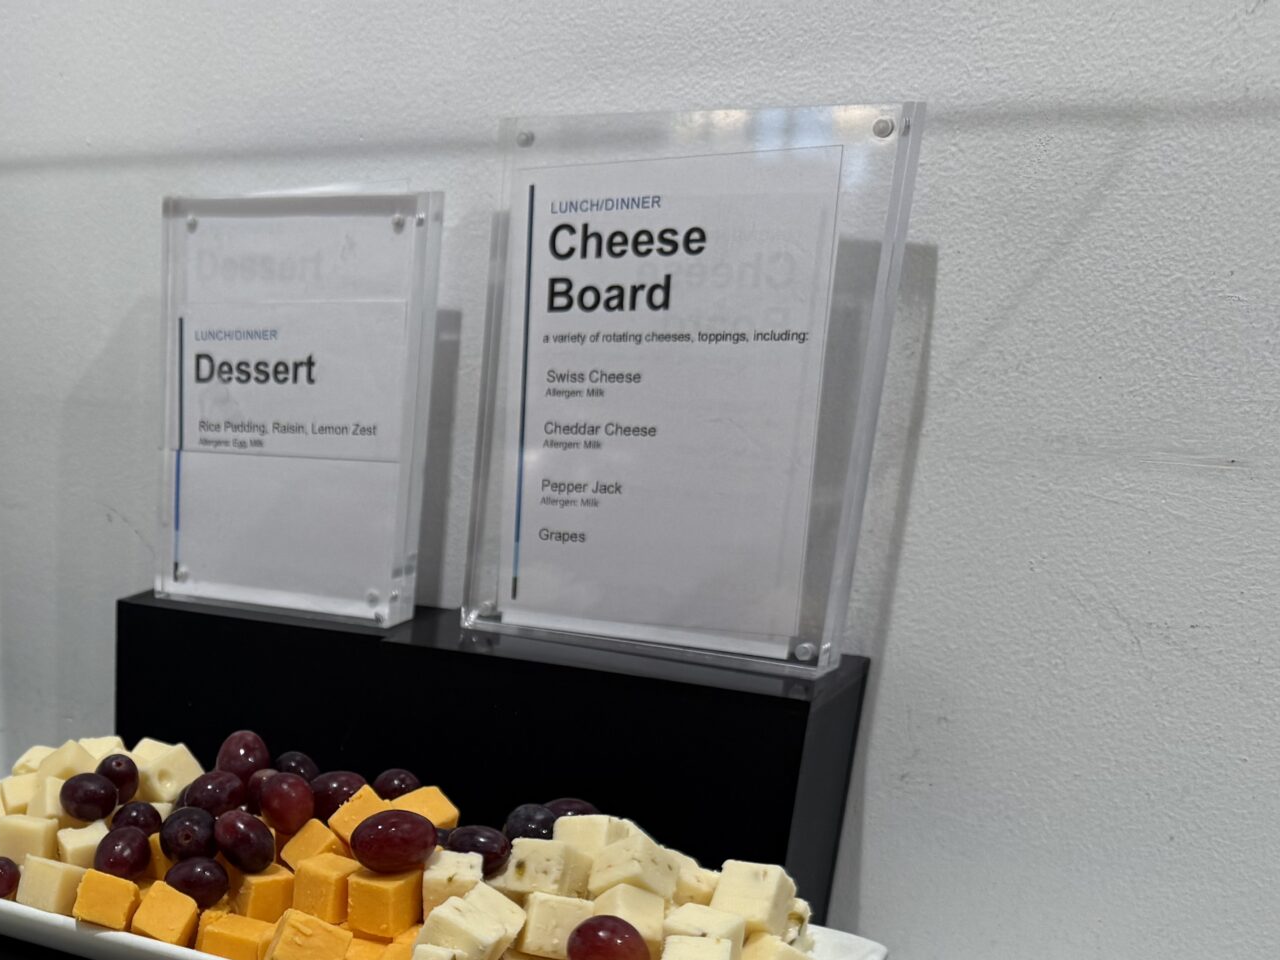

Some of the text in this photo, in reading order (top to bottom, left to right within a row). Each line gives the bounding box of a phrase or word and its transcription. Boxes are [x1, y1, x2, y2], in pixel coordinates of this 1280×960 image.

[550, 195, 662, 214] LUNCH/DINNER
[548, 223, 707, 261] Cheese
[547, 274, 672, 313] Board
[194, 329, 278, 341] LUNCH/DINNER
[543, 330, 809, 346] a variety of rotating cheeses, toppings, including:
[194, 353, 316, 385] Dessert
[546, 370, 642, 384] Swiss Cheese
[586, 388, 605, 397] Milk
[199, 420, 221, 433] Rice
[272, 422, 308, 436] Raisin,
[311, 423, 348, 436] Lemon
[352, 424, 377, 437] Zest
[543, 421, 657, 437] Cheddar Cheese
[583, 440, 602, 449] Milk
[541, 479, 622, 495] Pepper Jack
[580, 498, 599, 507] Milk
[538, 528, 586, 543] Grapes
